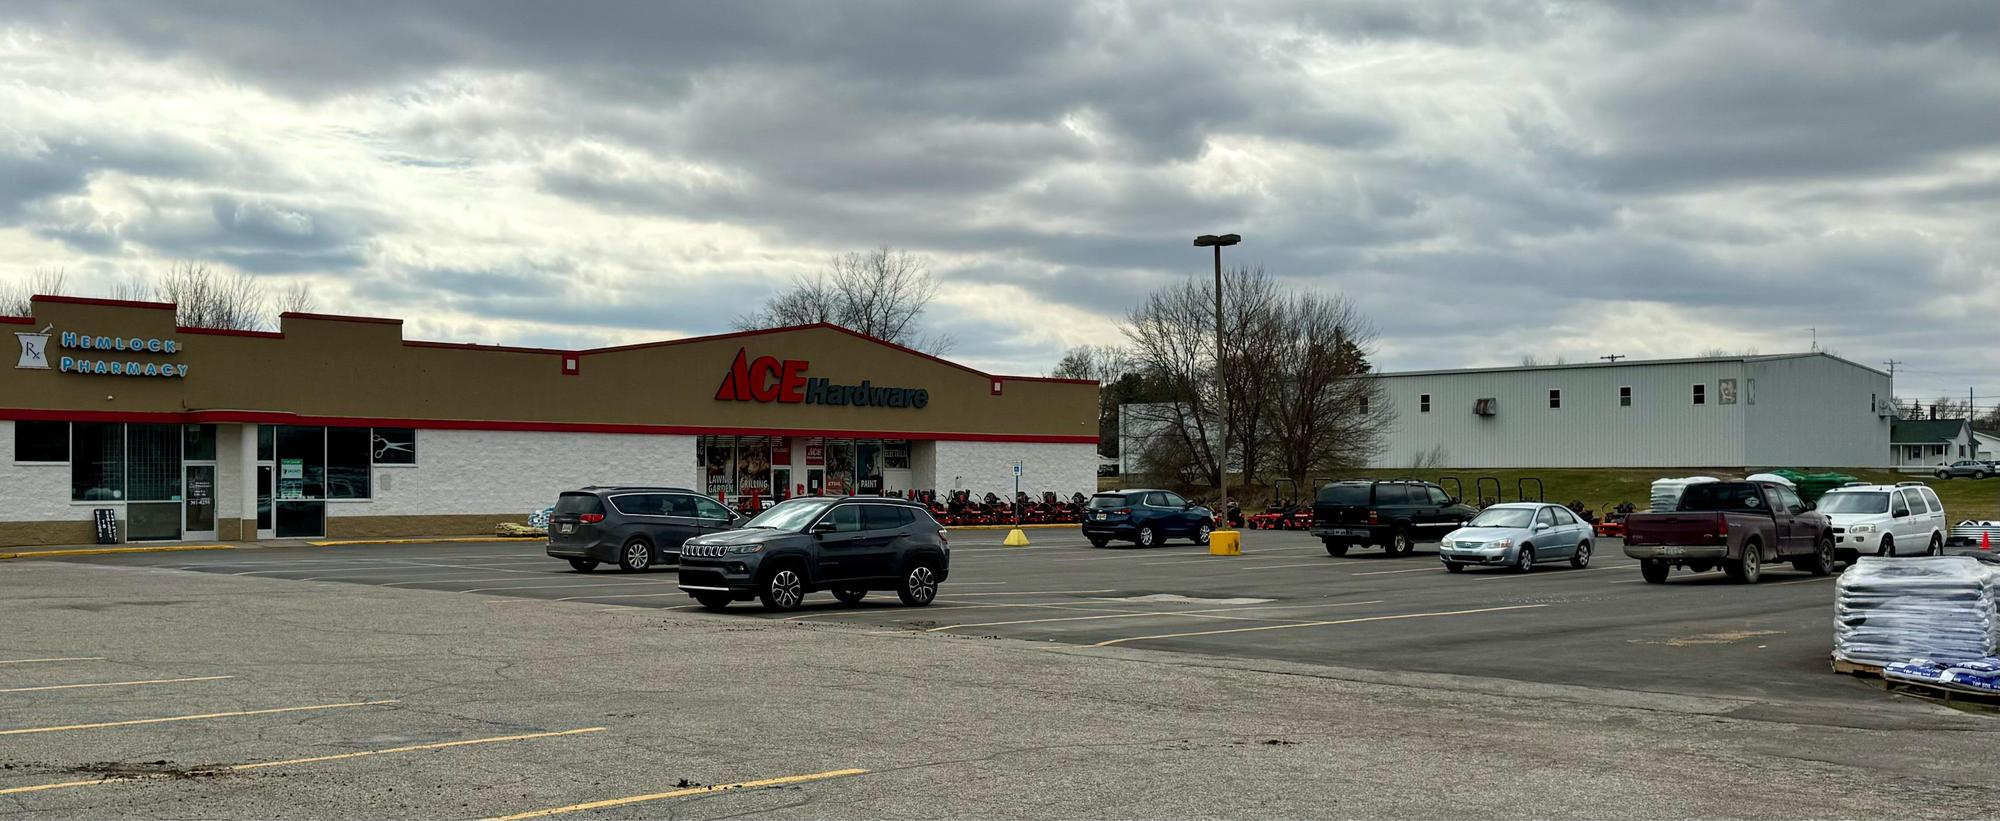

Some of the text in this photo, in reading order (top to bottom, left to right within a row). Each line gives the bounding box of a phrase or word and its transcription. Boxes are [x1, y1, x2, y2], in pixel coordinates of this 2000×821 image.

[62, 331, 176, 352] HEMLOCK
[60, 356, 189, 378] PHARMACY
[715, 346, 929, 409] ACE Hardware
[708, 484, 734, 493] GARDEN
[740, 479, 768, 489] GRILLING
[860, 479, 877, 488] PAINT
